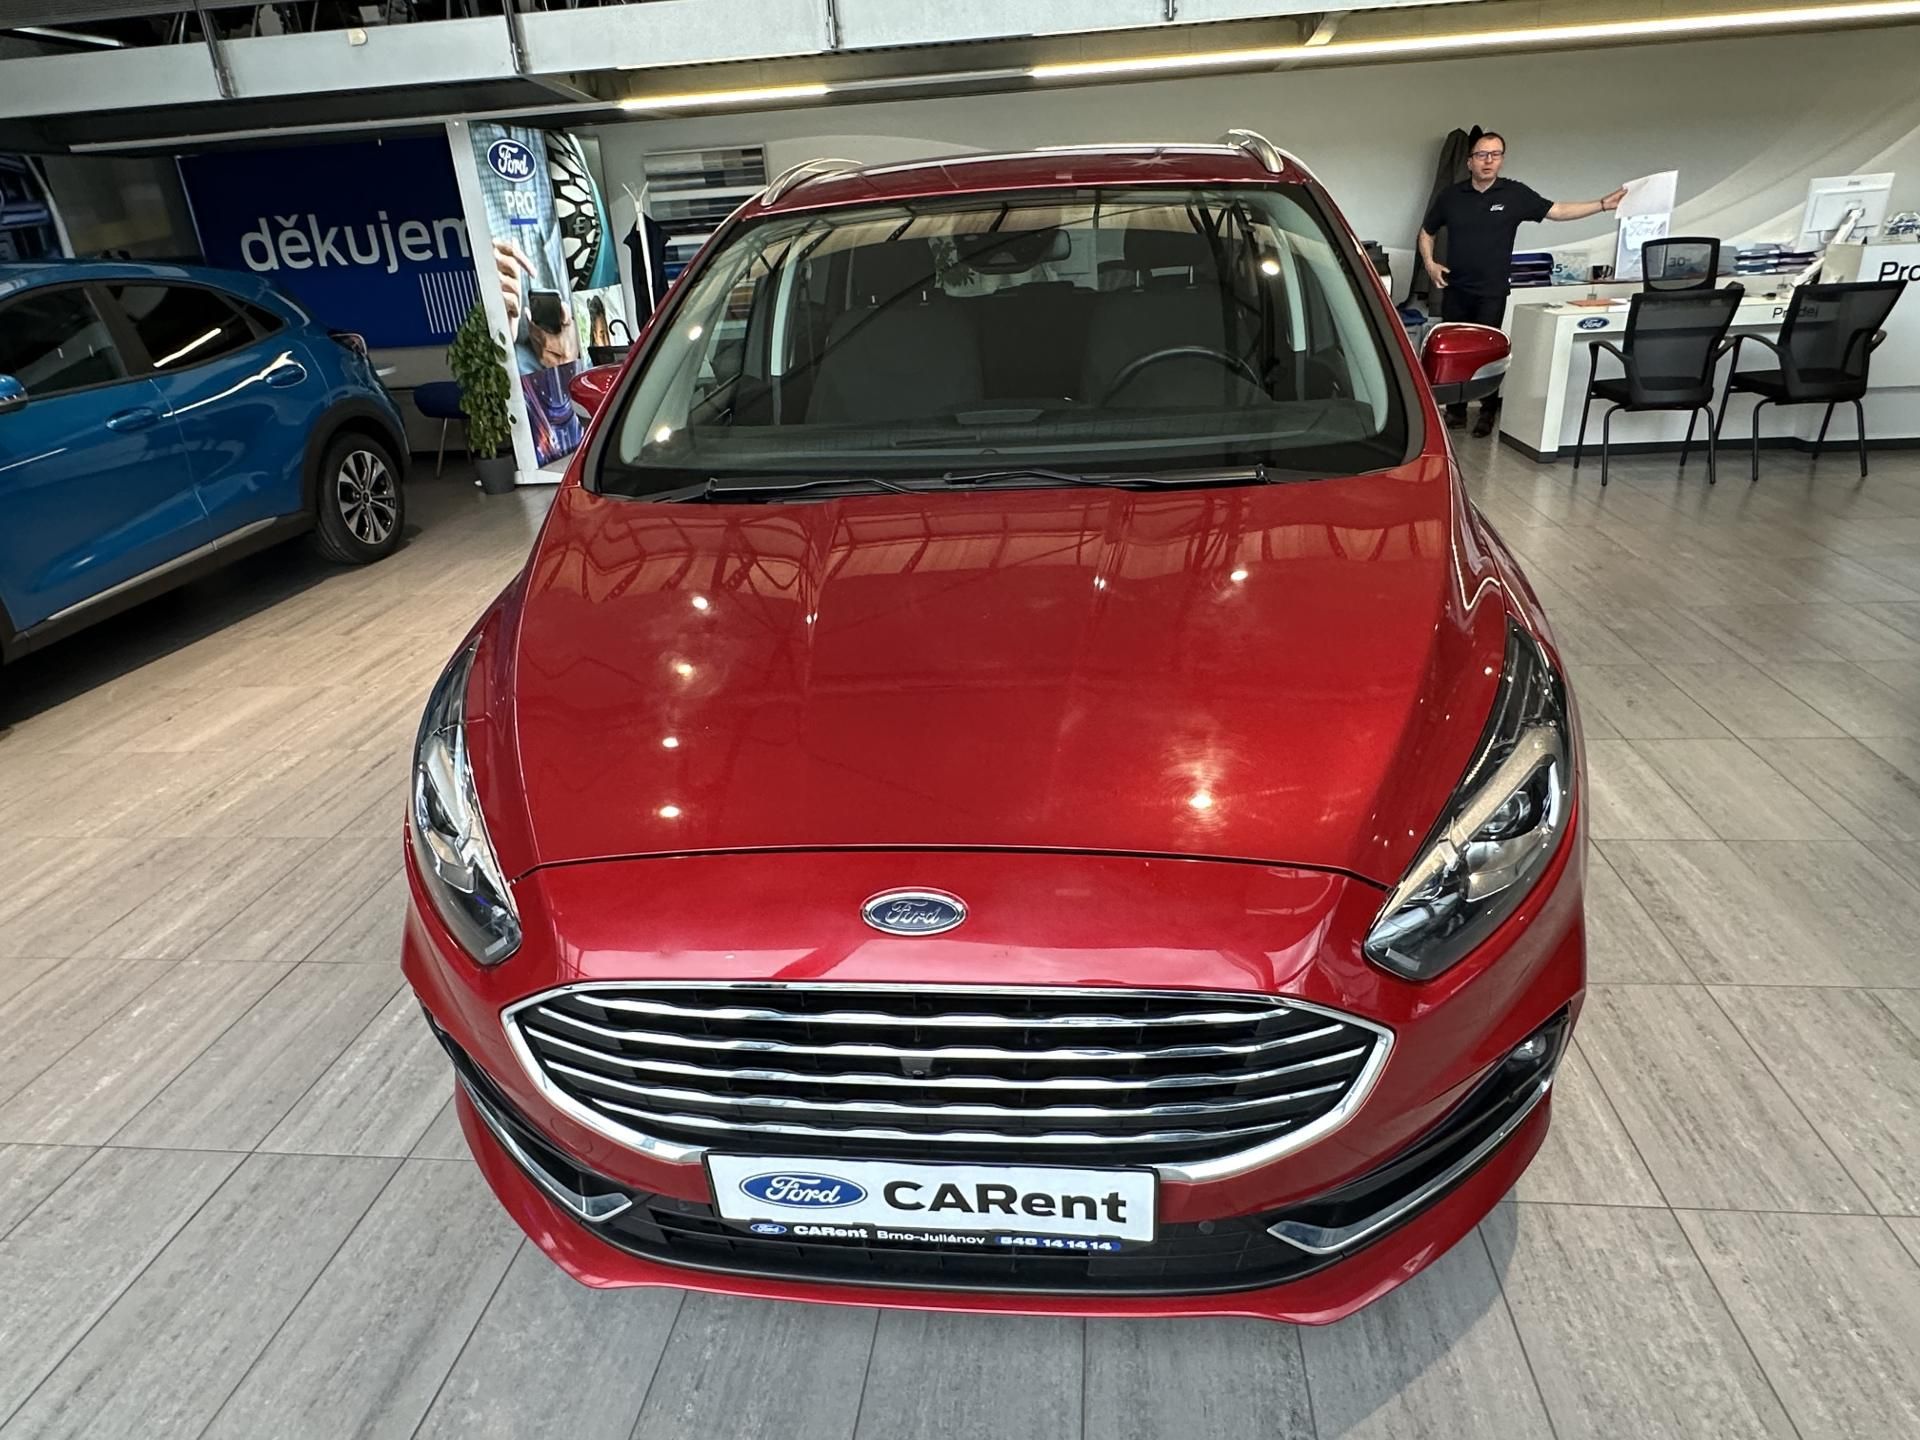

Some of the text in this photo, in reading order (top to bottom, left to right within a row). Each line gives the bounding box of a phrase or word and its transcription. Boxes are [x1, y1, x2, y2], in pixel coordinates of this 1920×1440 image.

[497, 143, 529, 176] Ford
[504, 190, 537, 216] PRO
[885, 900, 942, 924] Ford
[765, 1176, 1127, 1224] Ford CARent
[793, 1225, 868, 1239] CARent
